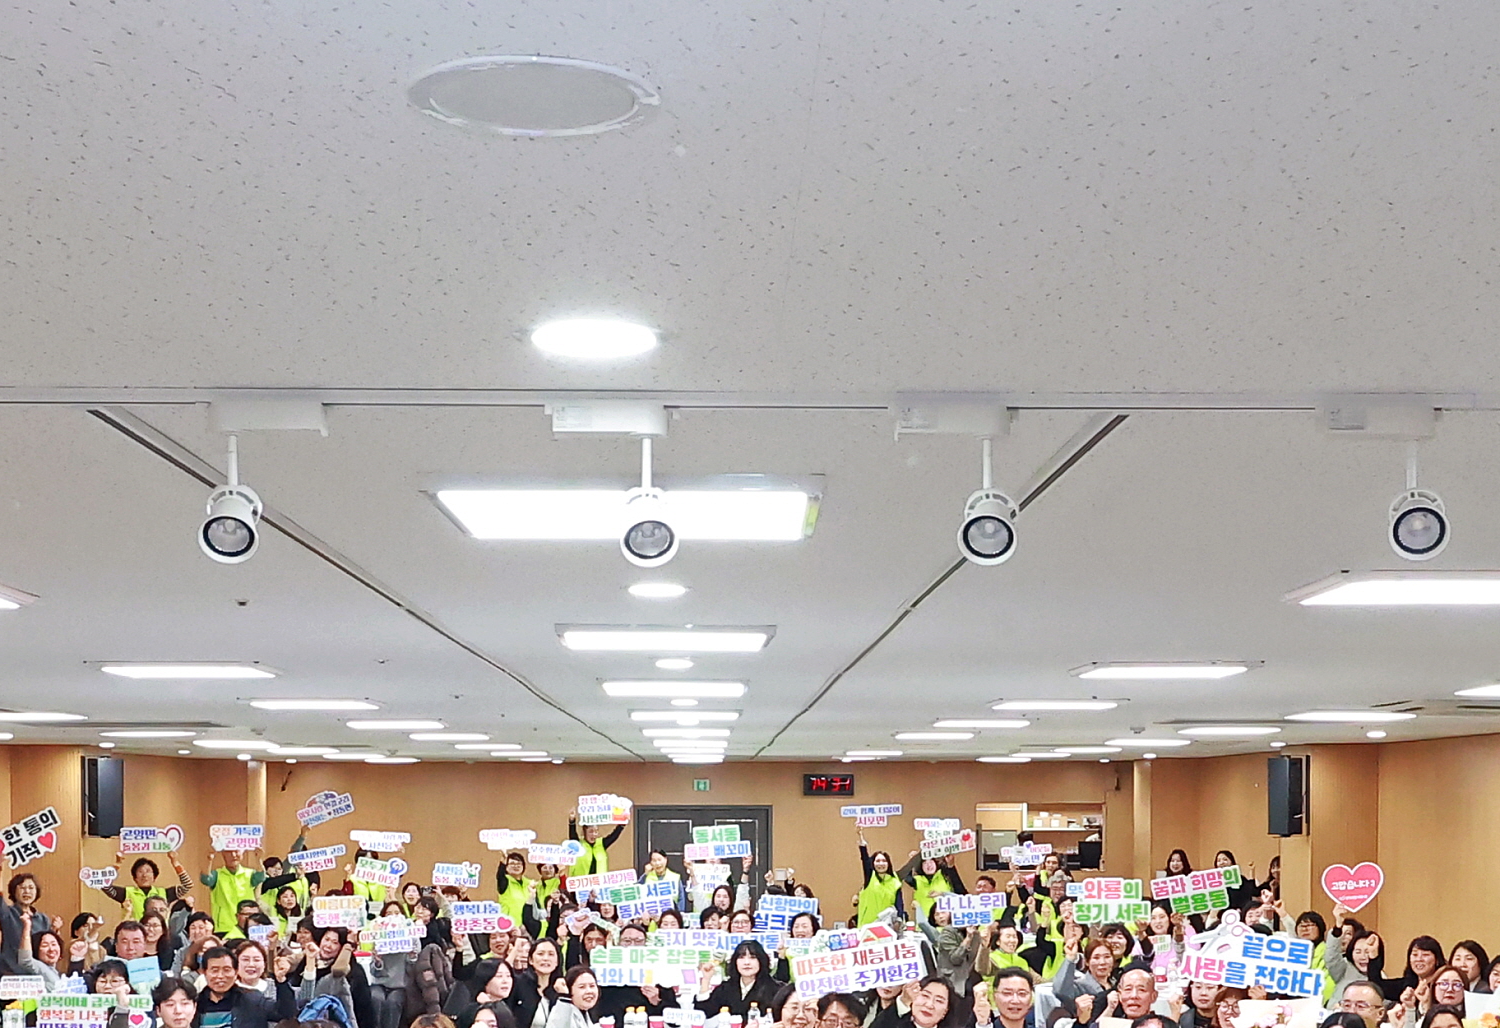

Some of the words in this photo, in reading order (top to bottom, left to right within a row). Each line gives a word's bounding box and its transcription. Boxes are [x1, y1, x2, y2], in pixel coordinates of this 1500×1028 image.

[1, 826, 22, 847] 한
[23, 809, 59, 837] 통의
[695, 827, 738, 843] 동서동
[6, 841, 40, 867] 기적
[304, 859, 334, 871] 정동면
[360, 859, 387, 871] 모두가
[356, 869, 376, 881] 나의
[377, 872, 398, 885] 이웃
[569, 876, 601, 890] 온기가득
[603, 872, 635, 885] 사랑가득
[1153, 878, 1187, 898] 꿈과
[1192, 867, 1240, 891] 희망의
[610, 886, 641, 903] 동금!
[646, 881, 676, 898] 서금!
[1084, 880, 1140, 900] 와룡의
[453, 903, 499, 915] 행복나눔
[619, 898, 672, 919] 동서금동
[761, 896, 816, 913] 신항만의
[979, 893, 1005, 908] 우리
[1172, 888, 1228, 914] 벌용동
[316, 912, 340, 926] 동행
[953, 911, 991, 925] 남양동
[1075, 903, 1109, 921] 정기
[1115, 903, 1149, 921] 서린
[454, 917, 496, 931] 향촌동
[360, 929, 406, 942] 이웃사랑의
[407, 925, 425, 937] 시작
[592, 949, 623, 964] 손을
[629, 949, 659, 964] 마주
[667, 949, 697, 965] 잡은
[1242, 935, 1311, 965] 끝으로
[796, 954, 847, 976] 따뜻한
[853, 944, 918, 967] 재능나눔
[629, 968, 645, 983] 나
[799, 974, 849, 996] 안전한
[855, 962, 920, 987] 주거환경
[1180, 955, 1247, 985] 사랑을
[1254, 965, 1323, 996] 전하다
[39, 996, 88, 1008] 삼복이네
[91, 997, 151, 1009] 급식사단
[39, 1010, 74, 1021] 행복을
[79, 1010, 108, 1021] 나누
